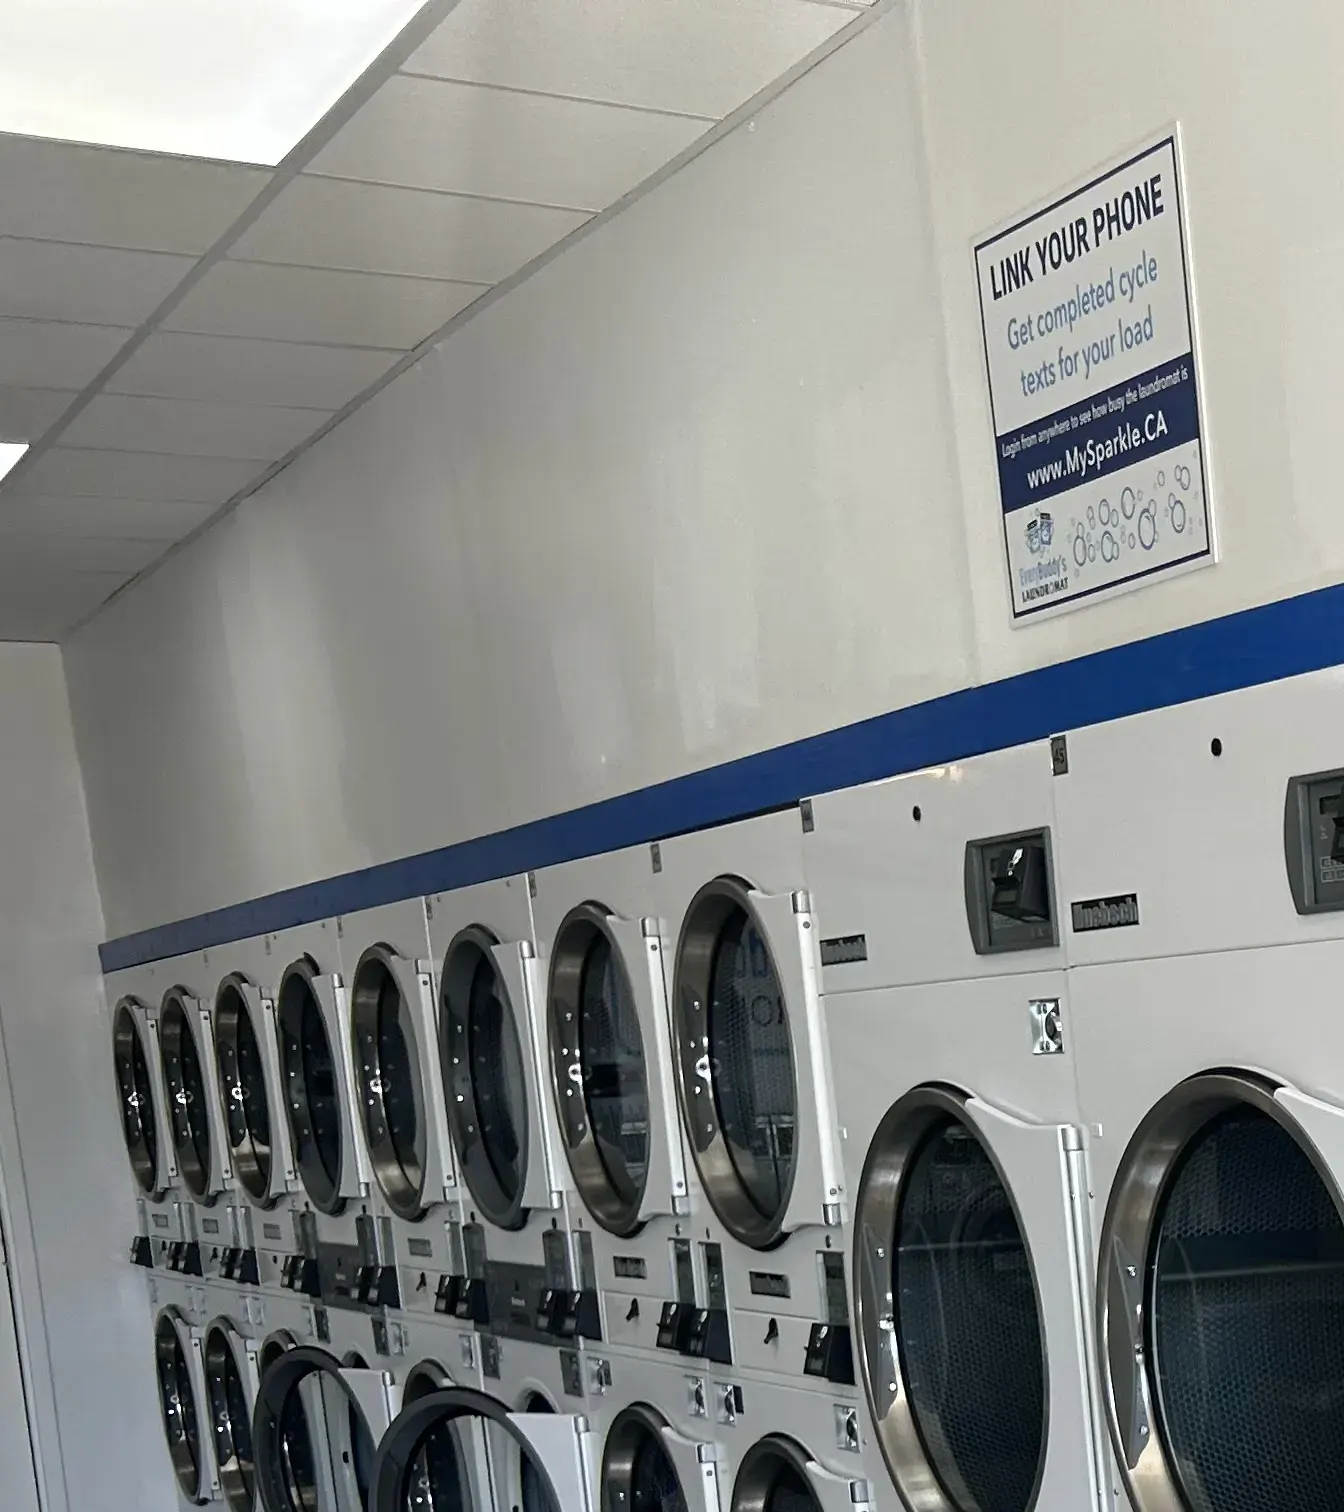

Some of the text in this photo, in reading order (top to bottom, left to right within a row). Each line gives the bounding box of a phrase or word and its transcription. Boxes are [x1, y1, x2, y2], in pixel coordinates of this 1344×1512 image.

[990, 174, 1164, 300] LINK YOUR PHONE
[1007, 249, 1158, 350] Get completed cycle
[1020, 304, 1154, 397] texts for your load
[1002, 364, 1189, 459] Login from anywhere to see how busy the laundromat is
[1026, 410, 1168, 489] www.MySparkle.CA
